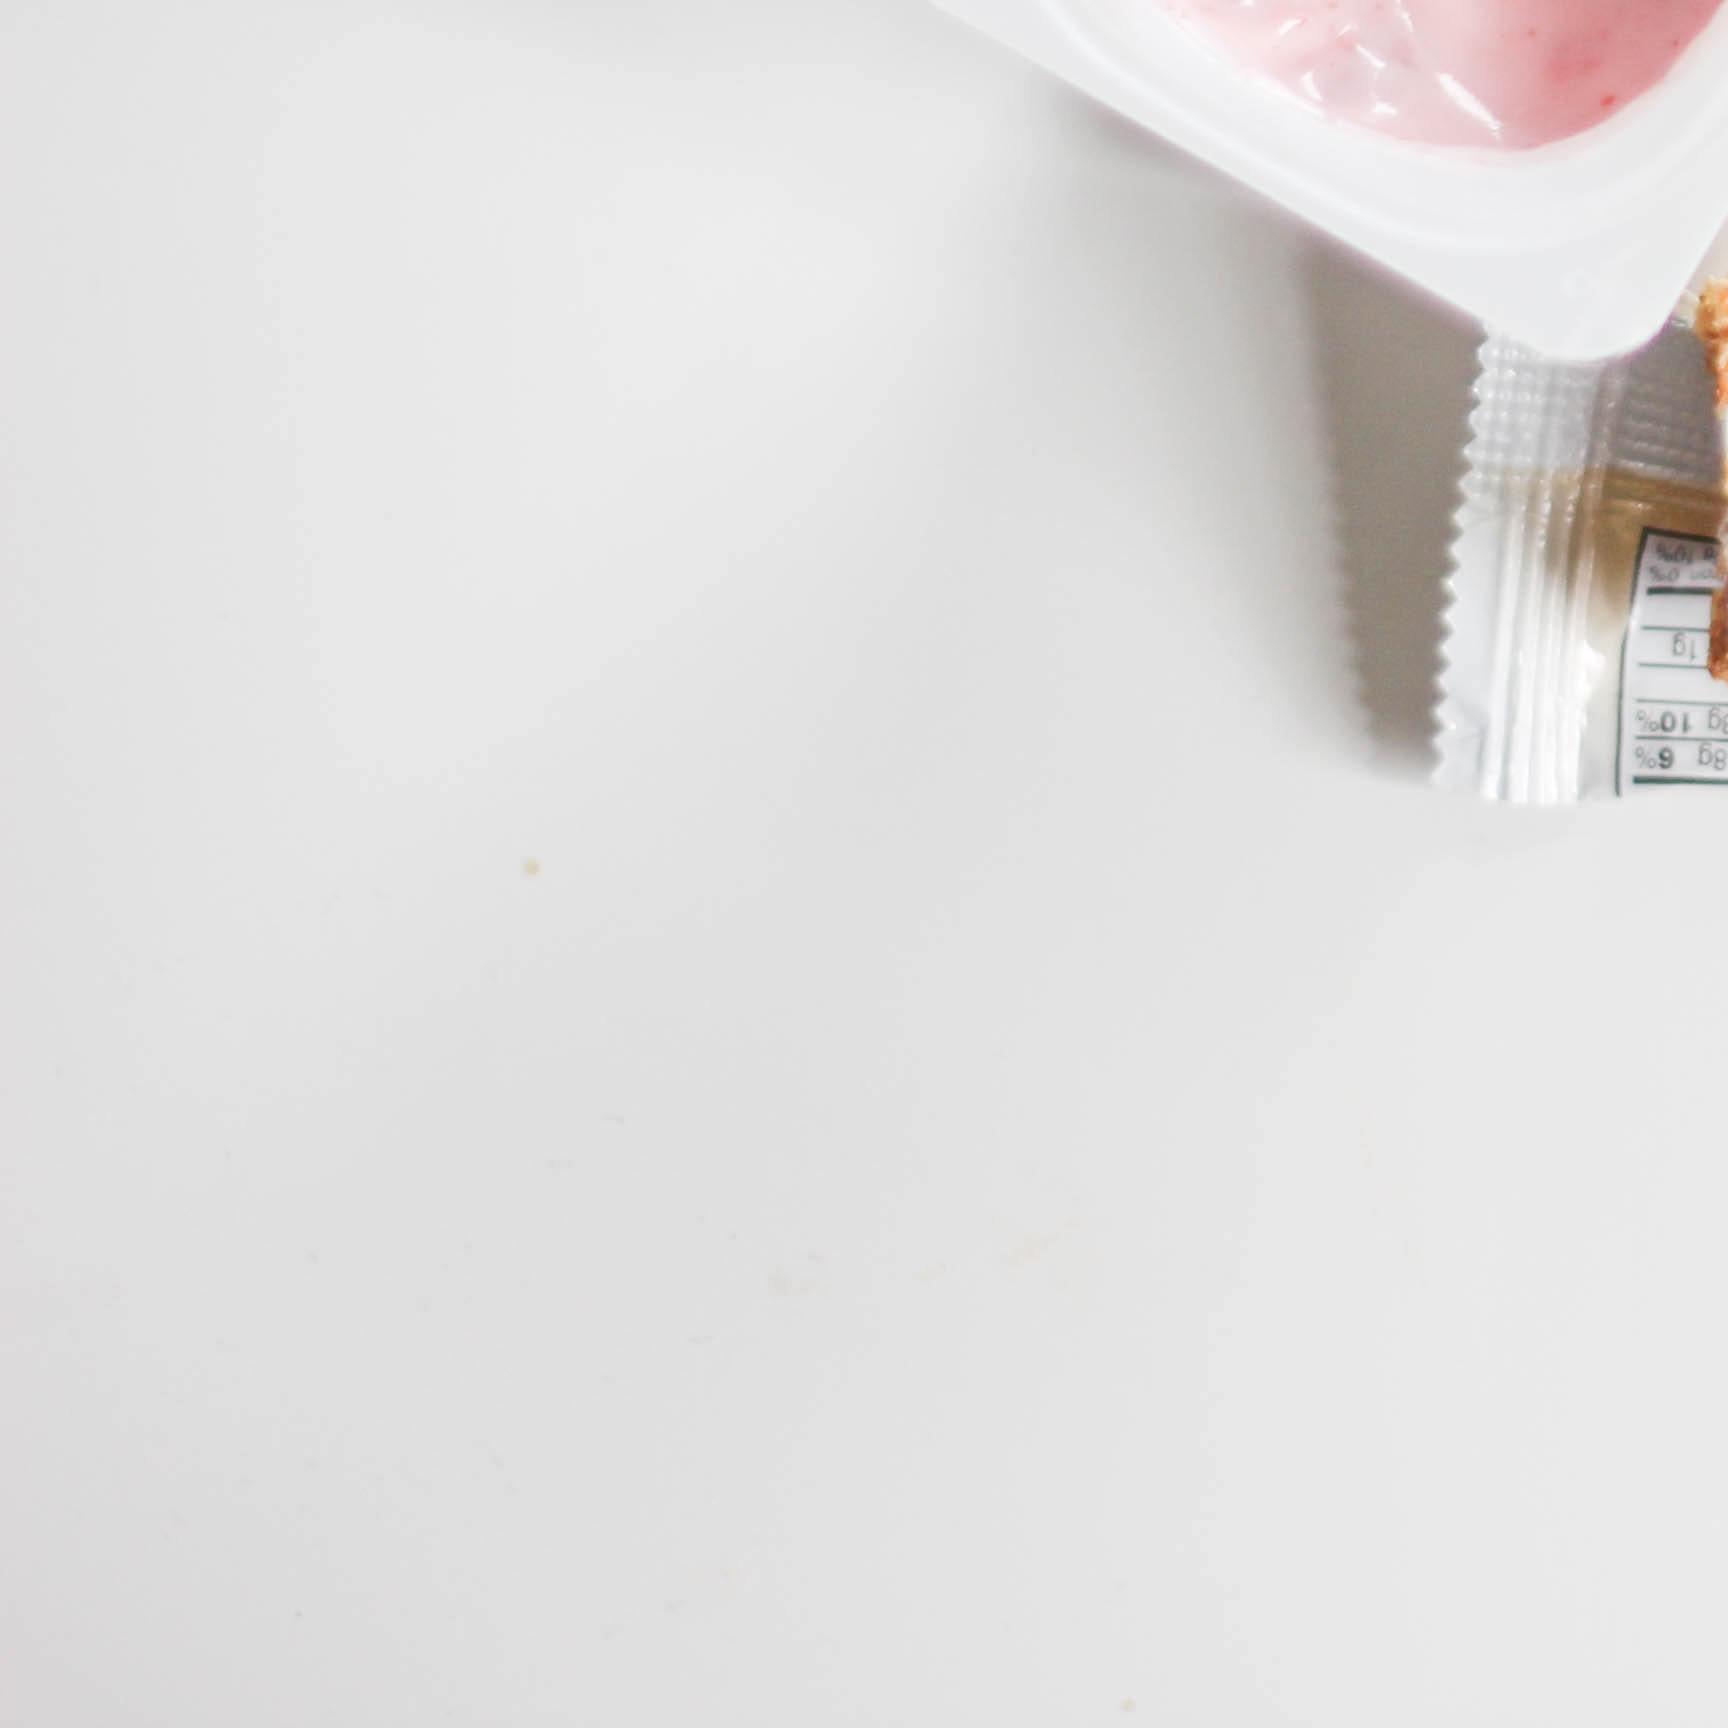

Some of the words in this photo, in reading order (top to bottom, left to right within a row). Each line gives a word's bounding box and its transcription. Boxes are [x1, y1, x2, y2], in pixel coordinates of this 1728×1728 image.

[1672, 632, 1697, 662] 1g
[1636, 709, 1691, 734] 10%
[1634, 745, 1675, 770] 6%
